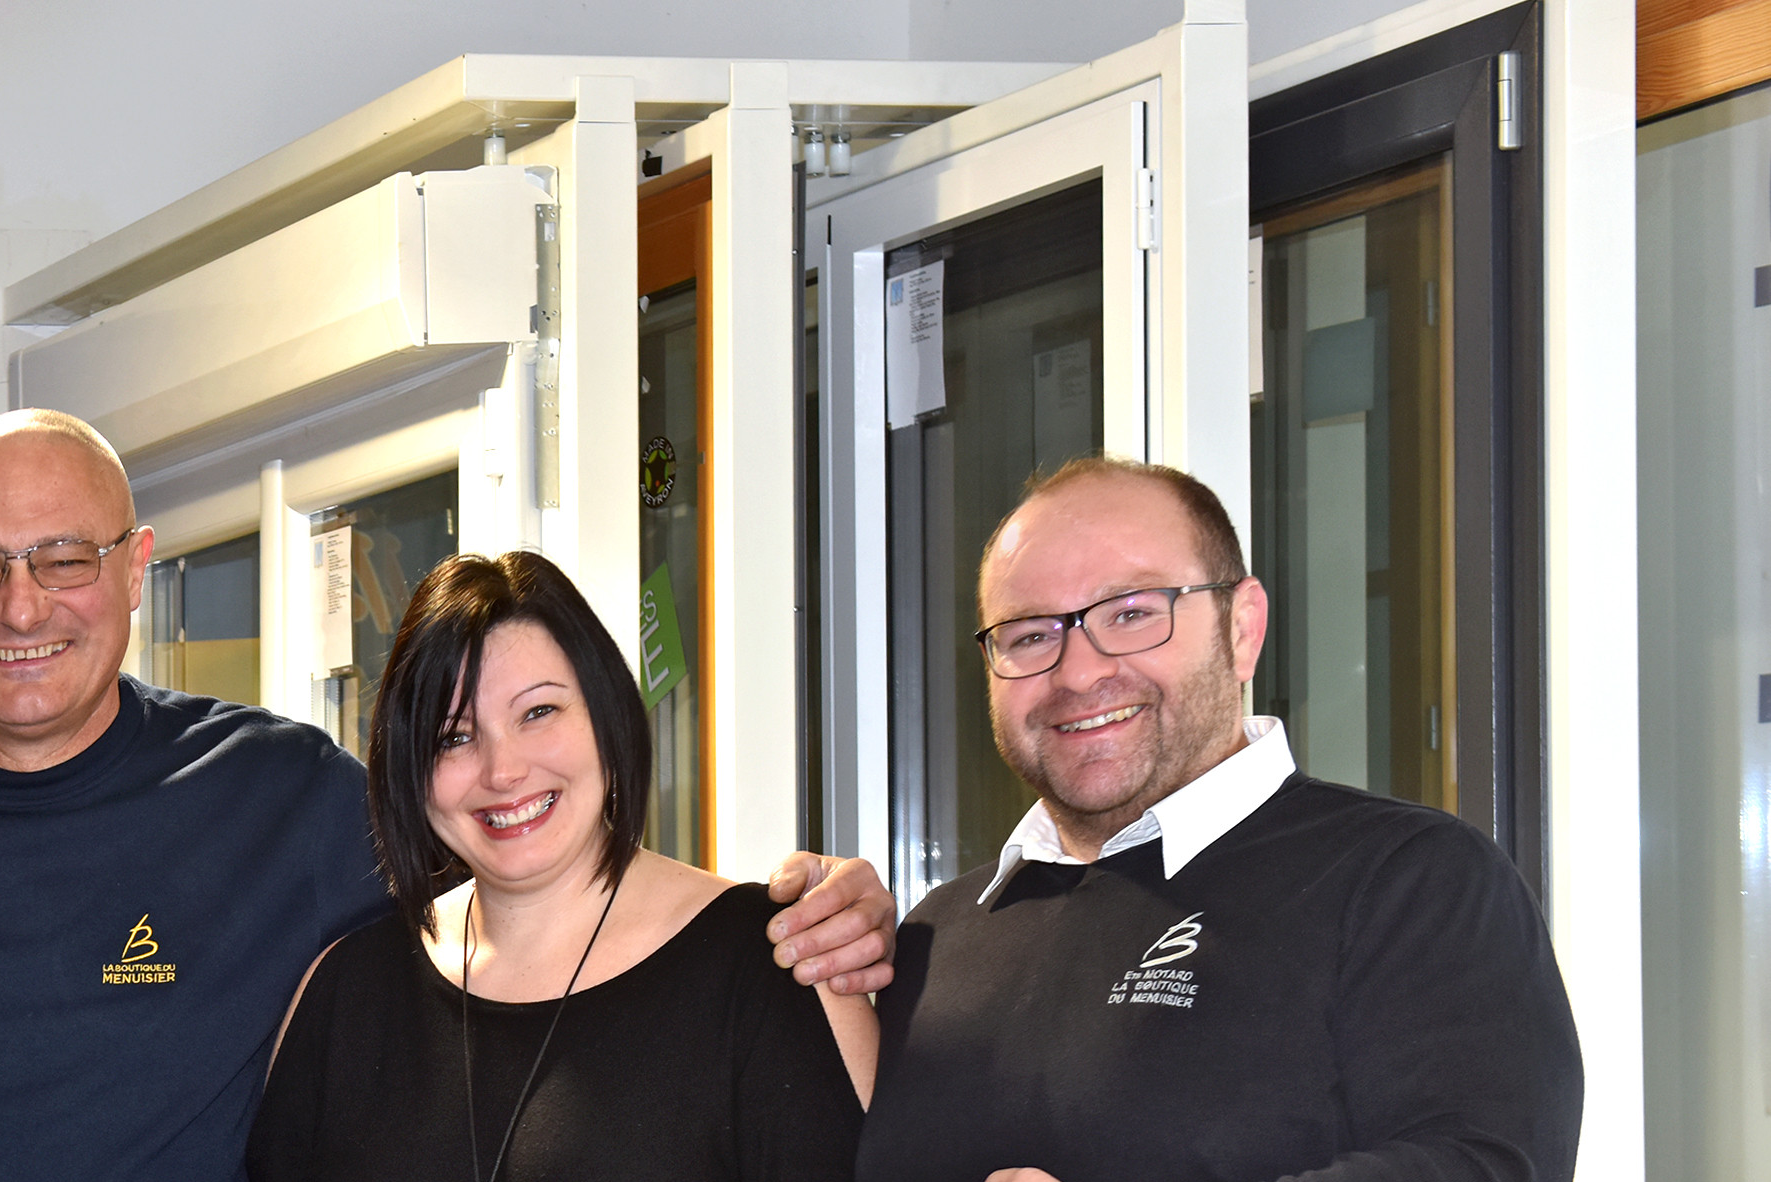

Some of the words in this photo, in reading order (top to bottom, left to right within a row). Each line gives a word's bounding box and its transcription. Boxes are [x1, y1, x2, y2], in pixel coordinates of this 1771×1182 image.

[642, 439, 665, 463] MADE
[102, 963, 114, 972] LA
[115, 963, 163, 973] BOUTIQUE
[162, 963, 176, 972] DU
[102, 972, 176, 984] MENUISIER
[1142, 969, 1194, 982] MOTARD
[1111, 982, 1128, 992] LA
[1134, 981, 1200, 995] BOUTIQUE
[1107, 993, 1126, 1004] DU
[1129, 992, 1195, 1009] MENUISIER
